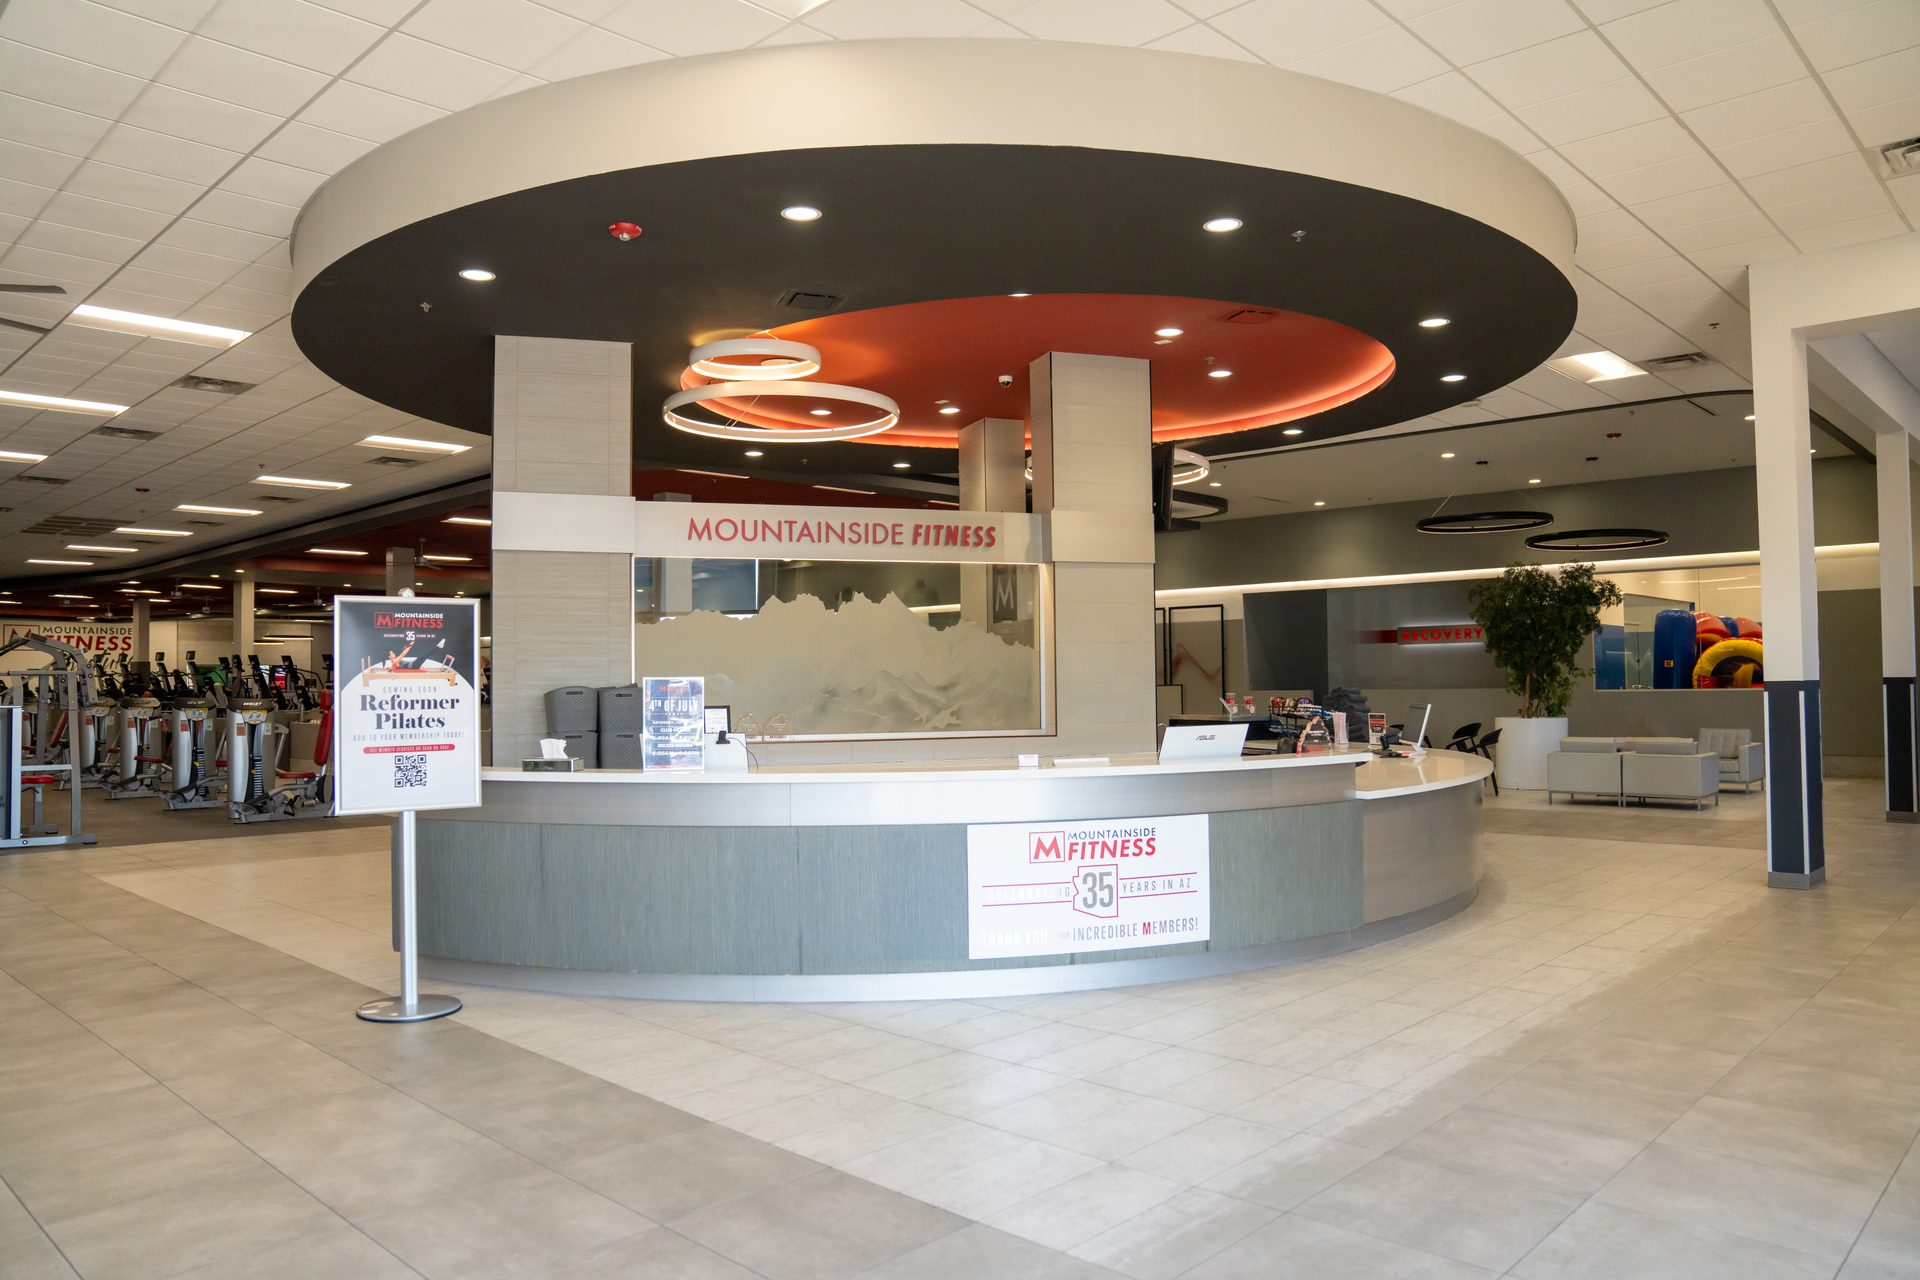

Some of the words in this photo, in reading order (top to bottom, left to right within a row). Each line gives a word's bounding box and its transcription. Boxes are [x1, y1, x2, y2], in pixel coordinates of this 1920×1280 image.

[687, 517, 904, 546] MOUNTAINSIDE
[911, 524, 997, 549] FITNESS
[995, 575, 1015, 612] M
[376, 613, 393, 628] M
[394, 612, 444, 620] MOUNTAINSIDE
[42, 625, 133, 636] MOUNTAINSIDE
[394, 618, 444, 629] FITNESS
[405, 631, 416, 641] 35
[1401, 627, 1484, 641] RECOVERY
[383, 686, 413, 694] COMING
[360, 694, 460, 712] Reformer
[664, 699, 675, 712] OF
[676, 699, 699, 712] JULY
[375, 712, 446, 730] Pilates
[352, 734, 366, 742] ADD
[380, 733, 397, 741] YOUR
[400, 732, 440, 740] MEMBERSHIP
[443, 731, 464, 739] TODAY!
[1067, 827, 1157, 841] MOUNTAINSIDE
[1033, 836, 1062, 860] M
[1067, 837, 1157, 861] FITNESS
[1081, 871, 1115, 909] 35
[1122, 879, 1157, 894] YEARS
[1162, 878, 1174, 890] IN
[1179, 877, 1191, 889] AZ
[981, 930, 1022, 947] THANK
[1024, 929, 1048, 945] YOU
[1072, 922, 1138, 942] INCREDIBLE
[1142, 917, 1198, 936] MEMBERS!
